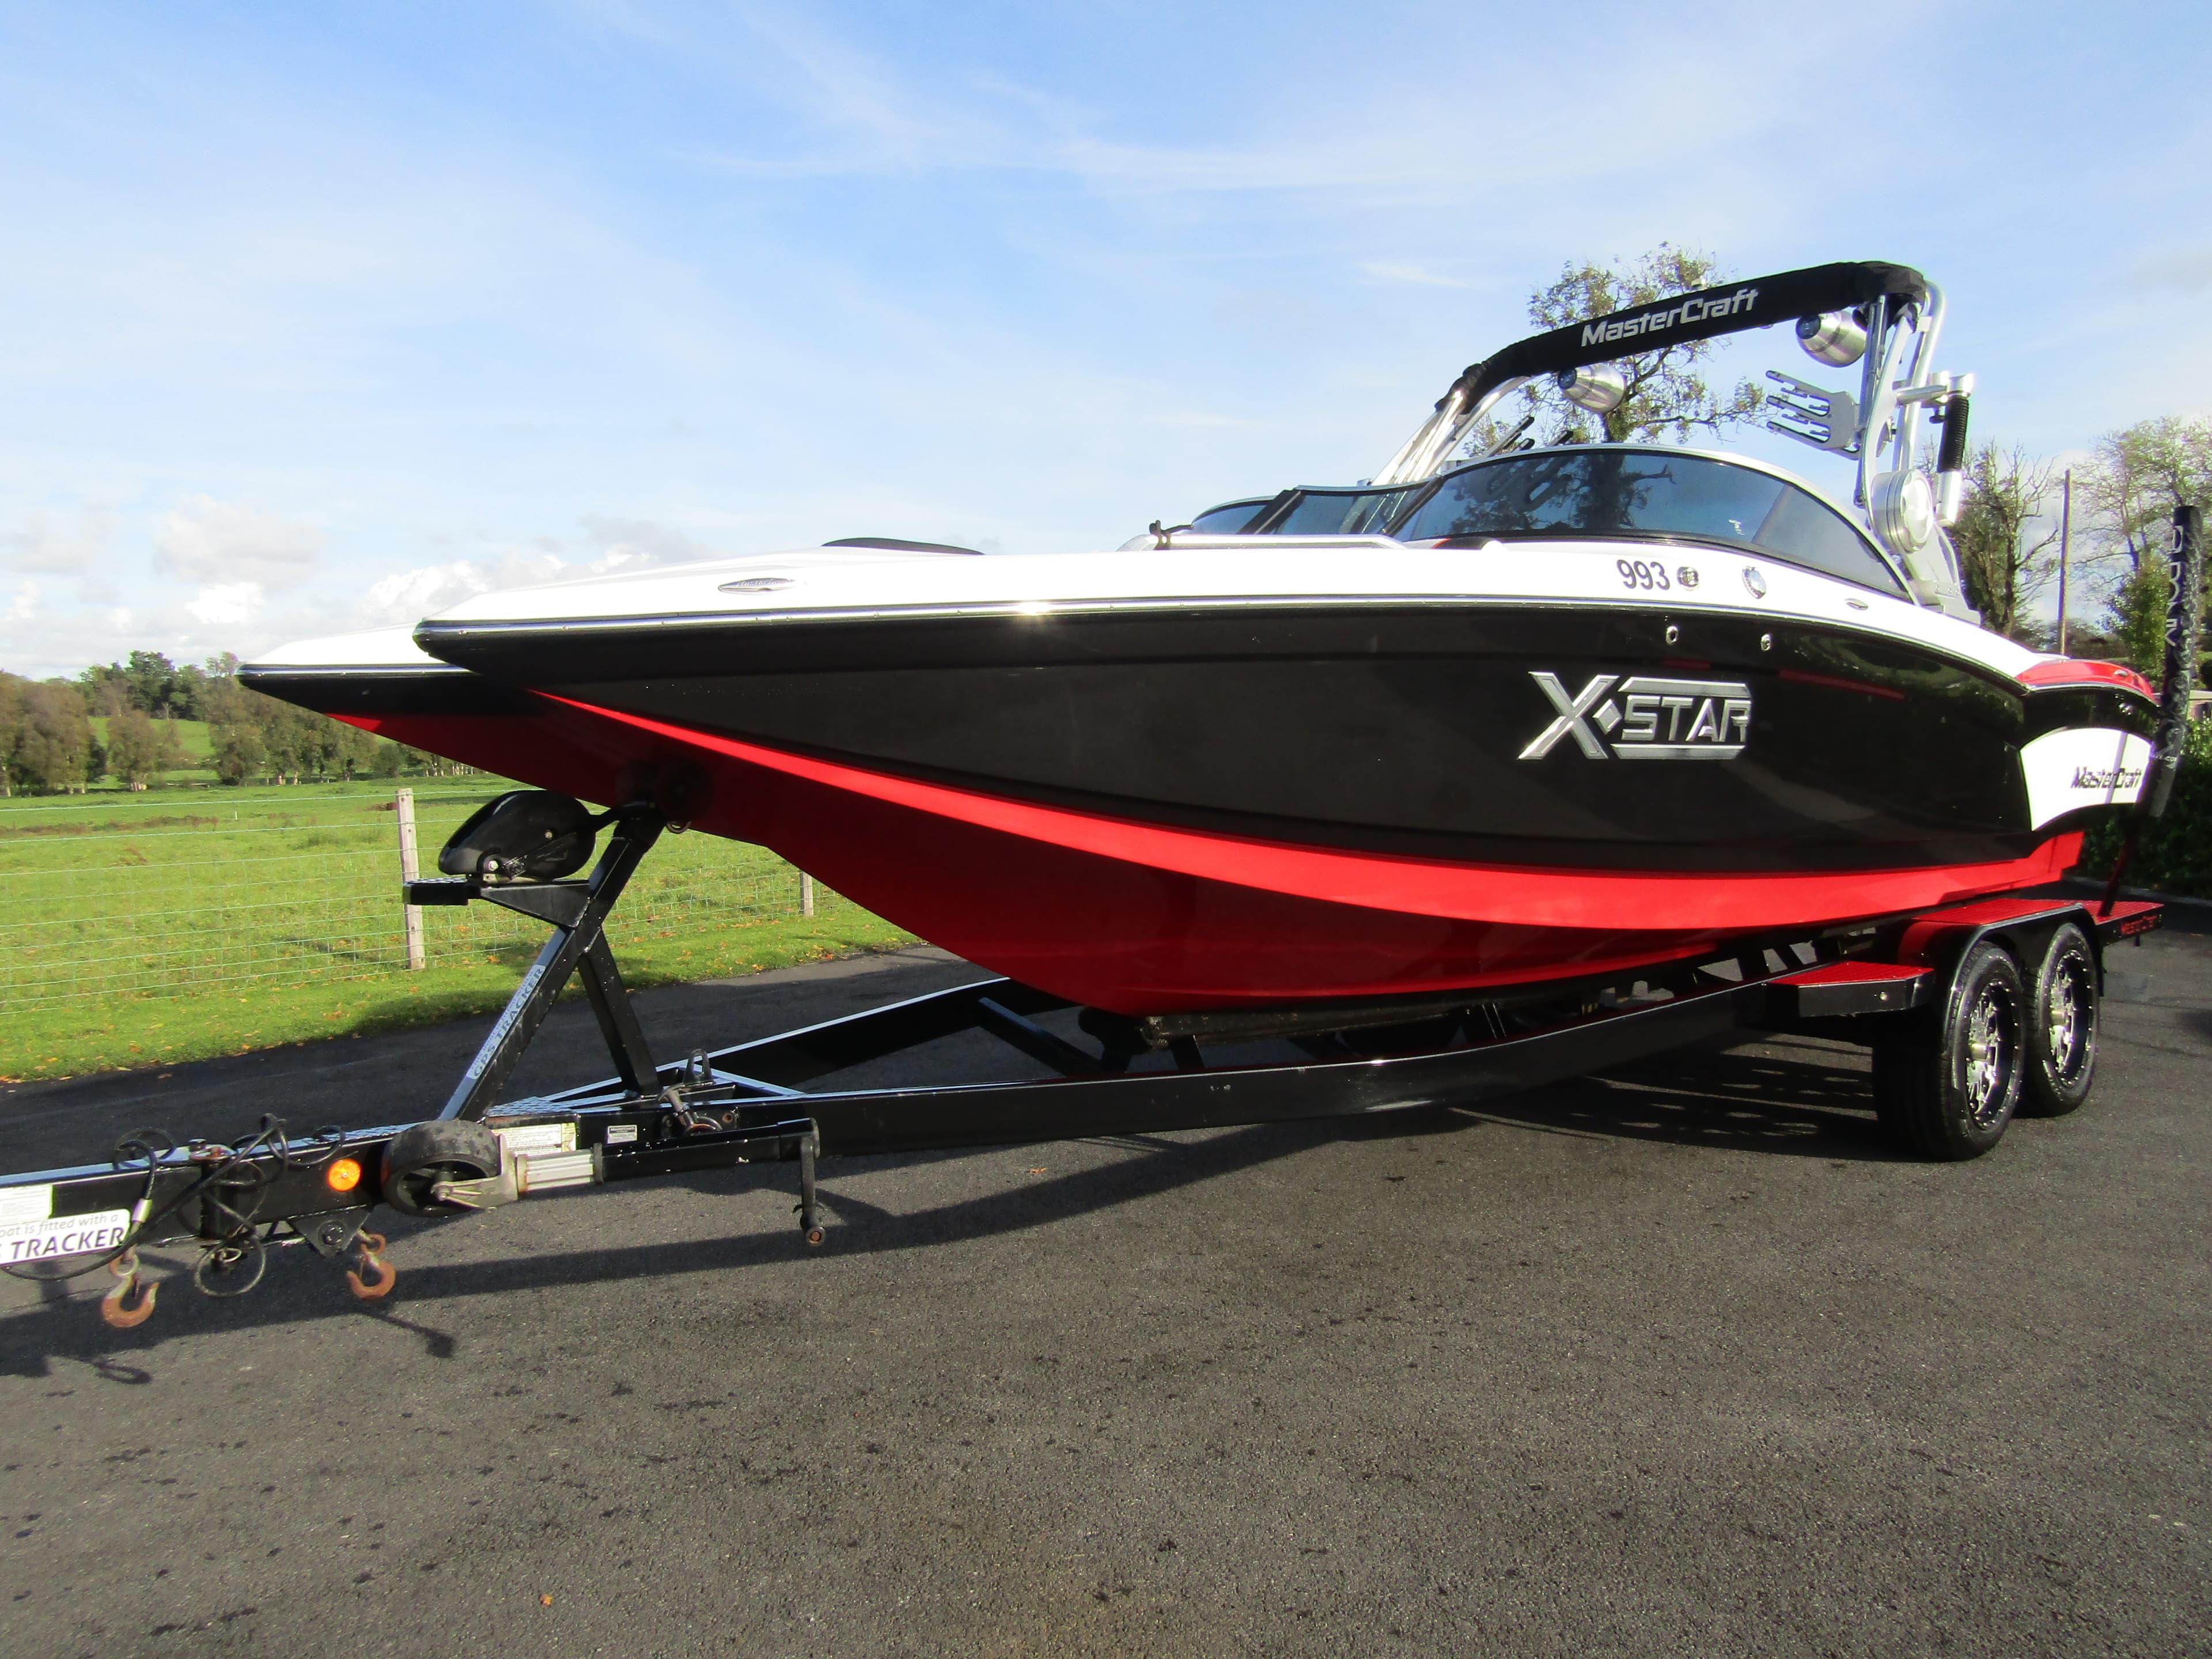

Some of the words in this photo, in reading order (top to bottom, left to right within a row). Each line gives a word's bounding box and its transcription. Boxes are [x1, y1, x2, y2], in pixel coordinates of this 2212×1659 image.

[1581, 287, 1759, 347] MasterCraft
[1616, 559, 1671, 590] 993
[473, 1044, 498, 1077] GPS
[495, 968, 543, 1039] TRACKER
[0, 1226, 21, 1238] oat
[36, 1217, 75, 1236] fitted
[78, 1213, 107, 1226] with
[110, 1214, 118, 1222] a
[10, 1226, 125, 1260] TRACKER
